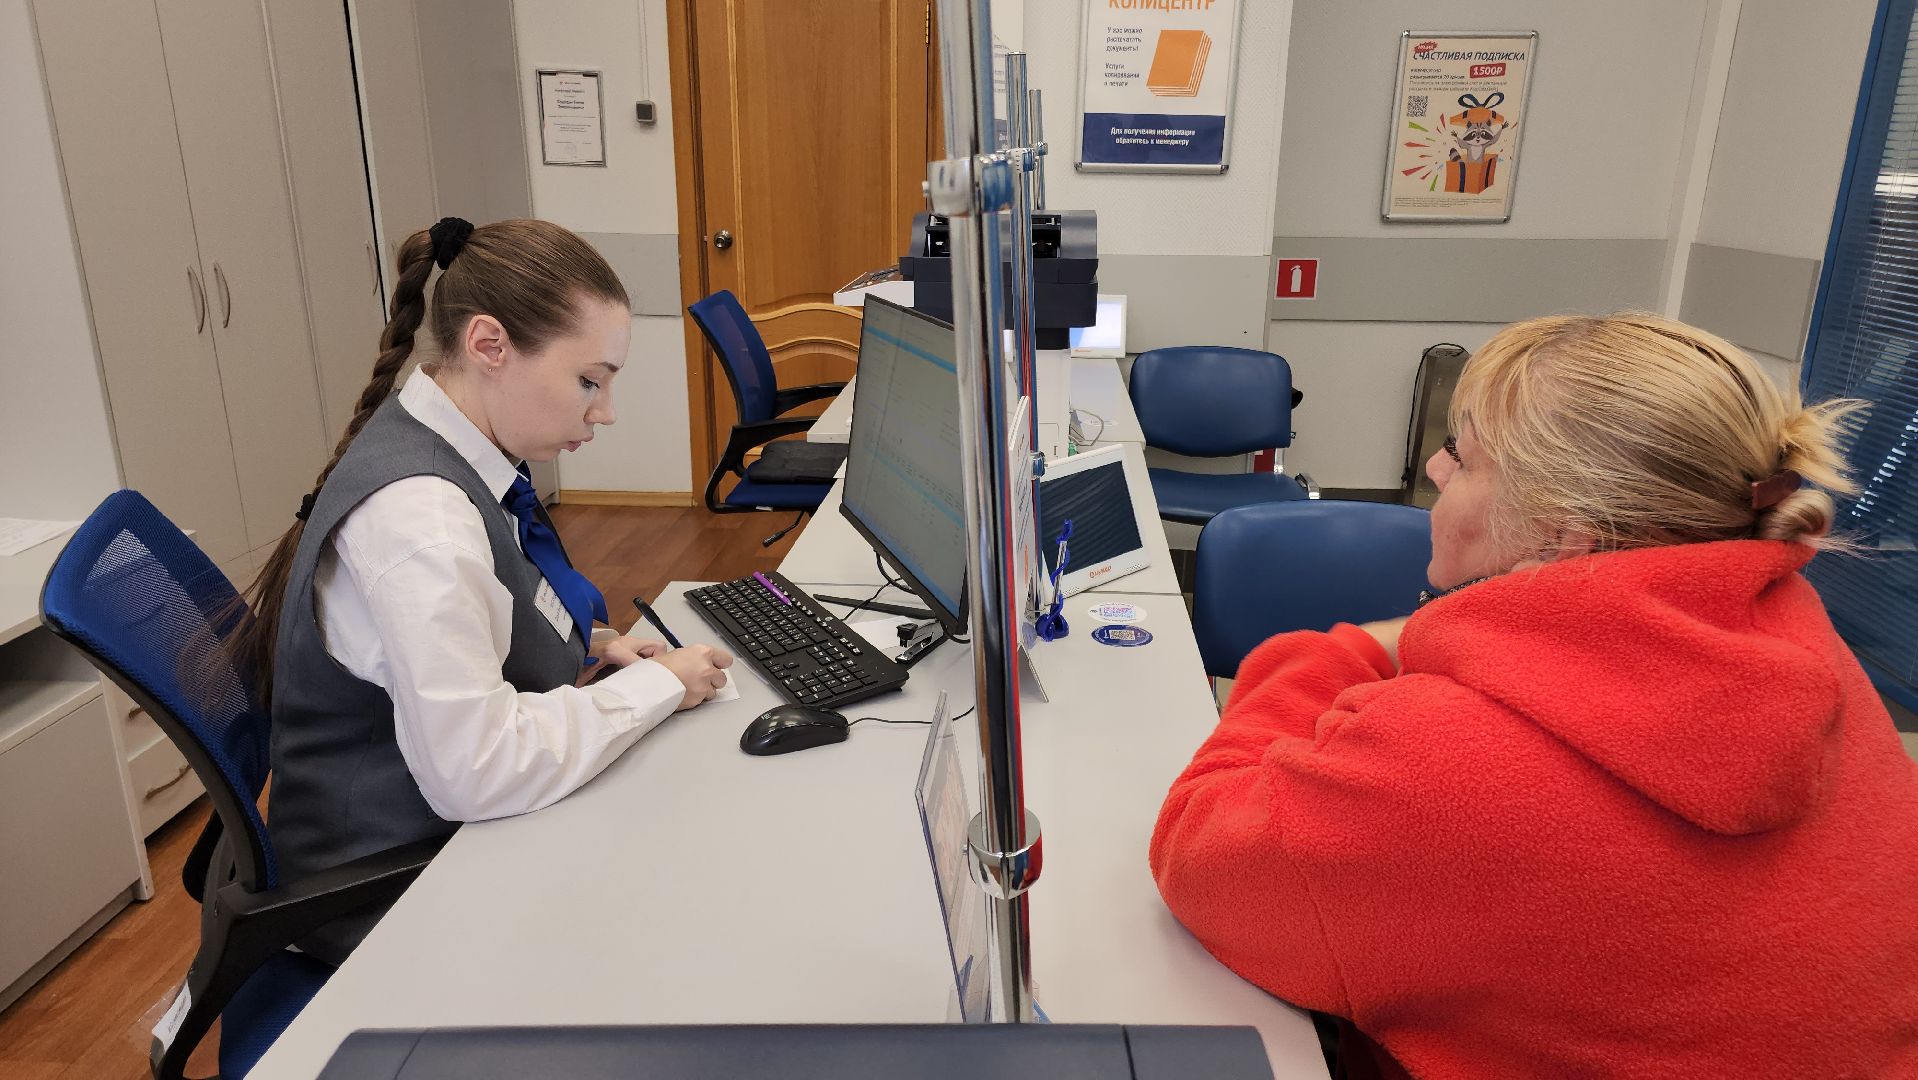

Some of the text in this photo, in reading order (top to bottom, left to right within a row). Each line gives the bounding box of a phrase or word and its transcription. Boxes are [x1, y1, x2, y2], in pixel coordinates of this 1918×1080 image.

[1413, 52, 1525, 61] СЧАСТЛИВАЯ ПОДПИСКА
[1110, 127, 1196, 137] Для получения информации
[1115, 137, 1149, 145] обратитесь
[1155, 138, 1190, 146] менеджеру
